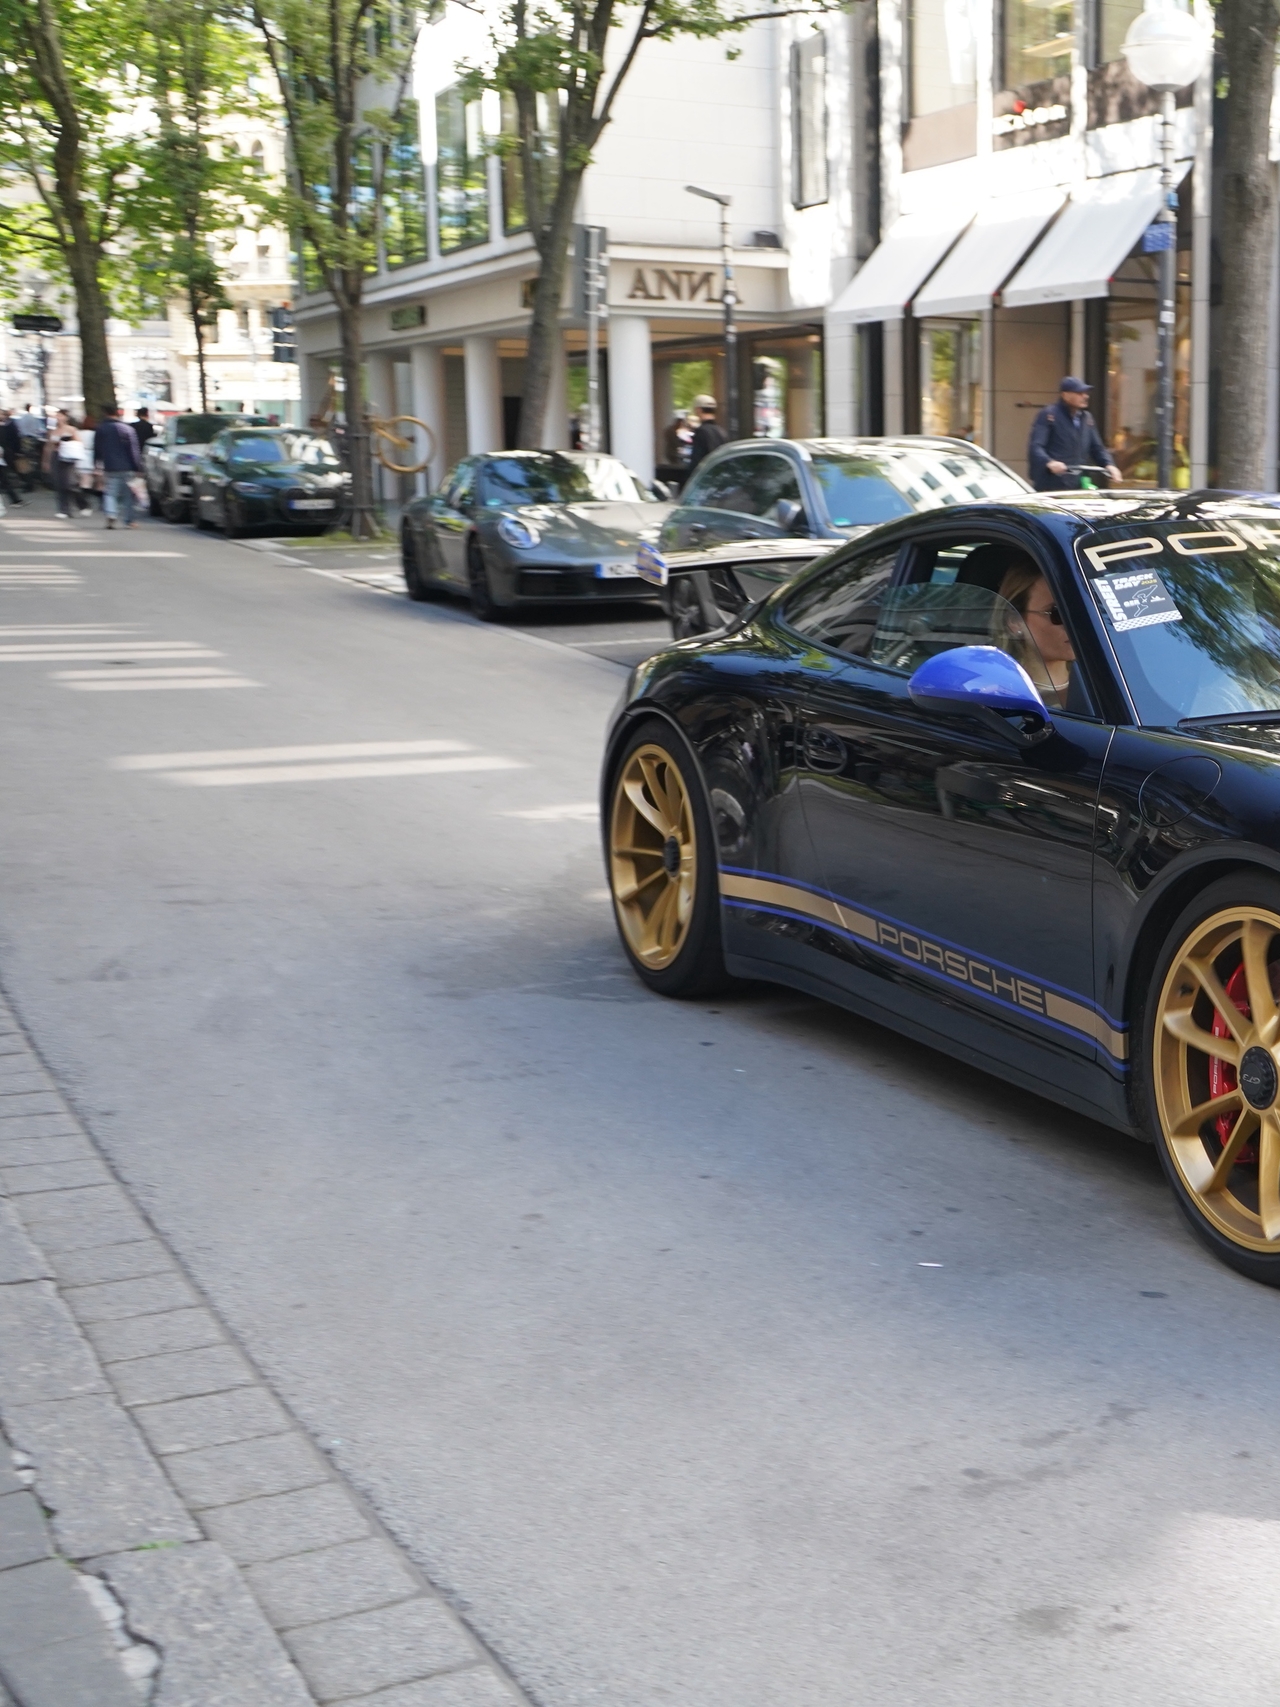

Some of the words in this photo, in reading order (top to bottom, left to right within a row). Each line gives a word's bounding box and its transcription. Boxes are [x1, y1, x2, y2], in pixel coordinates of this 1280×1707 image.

[1112, 573, 1154, 585] TRACK
[1115, 581, 1140, 590] DAY
[1094, 578, 1127, 620] STREET
[880, 921, 1046, 1014] PORSCHE
[1242, 1073, 1261, 1085] GT3
